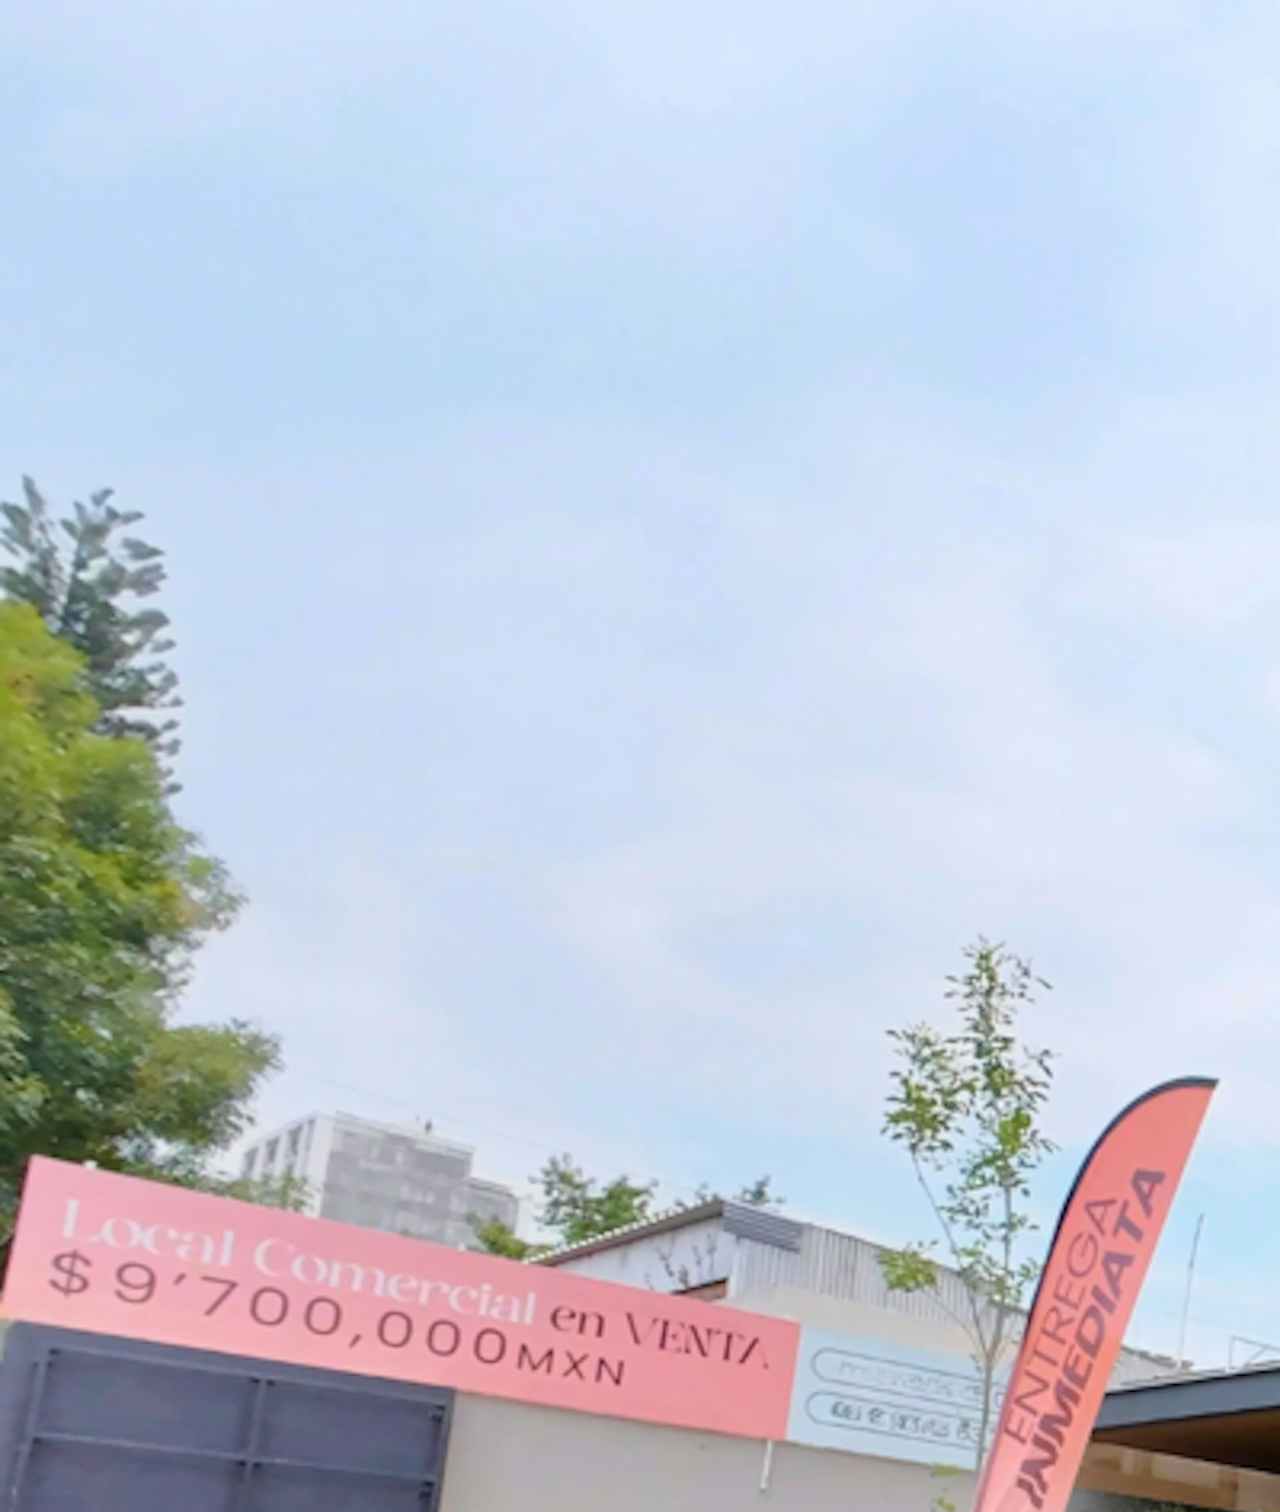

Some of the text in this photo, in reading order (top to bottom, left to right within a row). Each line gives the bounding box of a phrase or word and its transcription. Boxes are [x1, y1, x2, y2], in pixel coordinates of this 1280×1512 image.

[61, 1199, 770, 1370] Local Comercial en VENTA
[1003, 1197, 1117, 1443] ENTREGA
[1015, 1167, 1166, 1510] INMEDIATA
